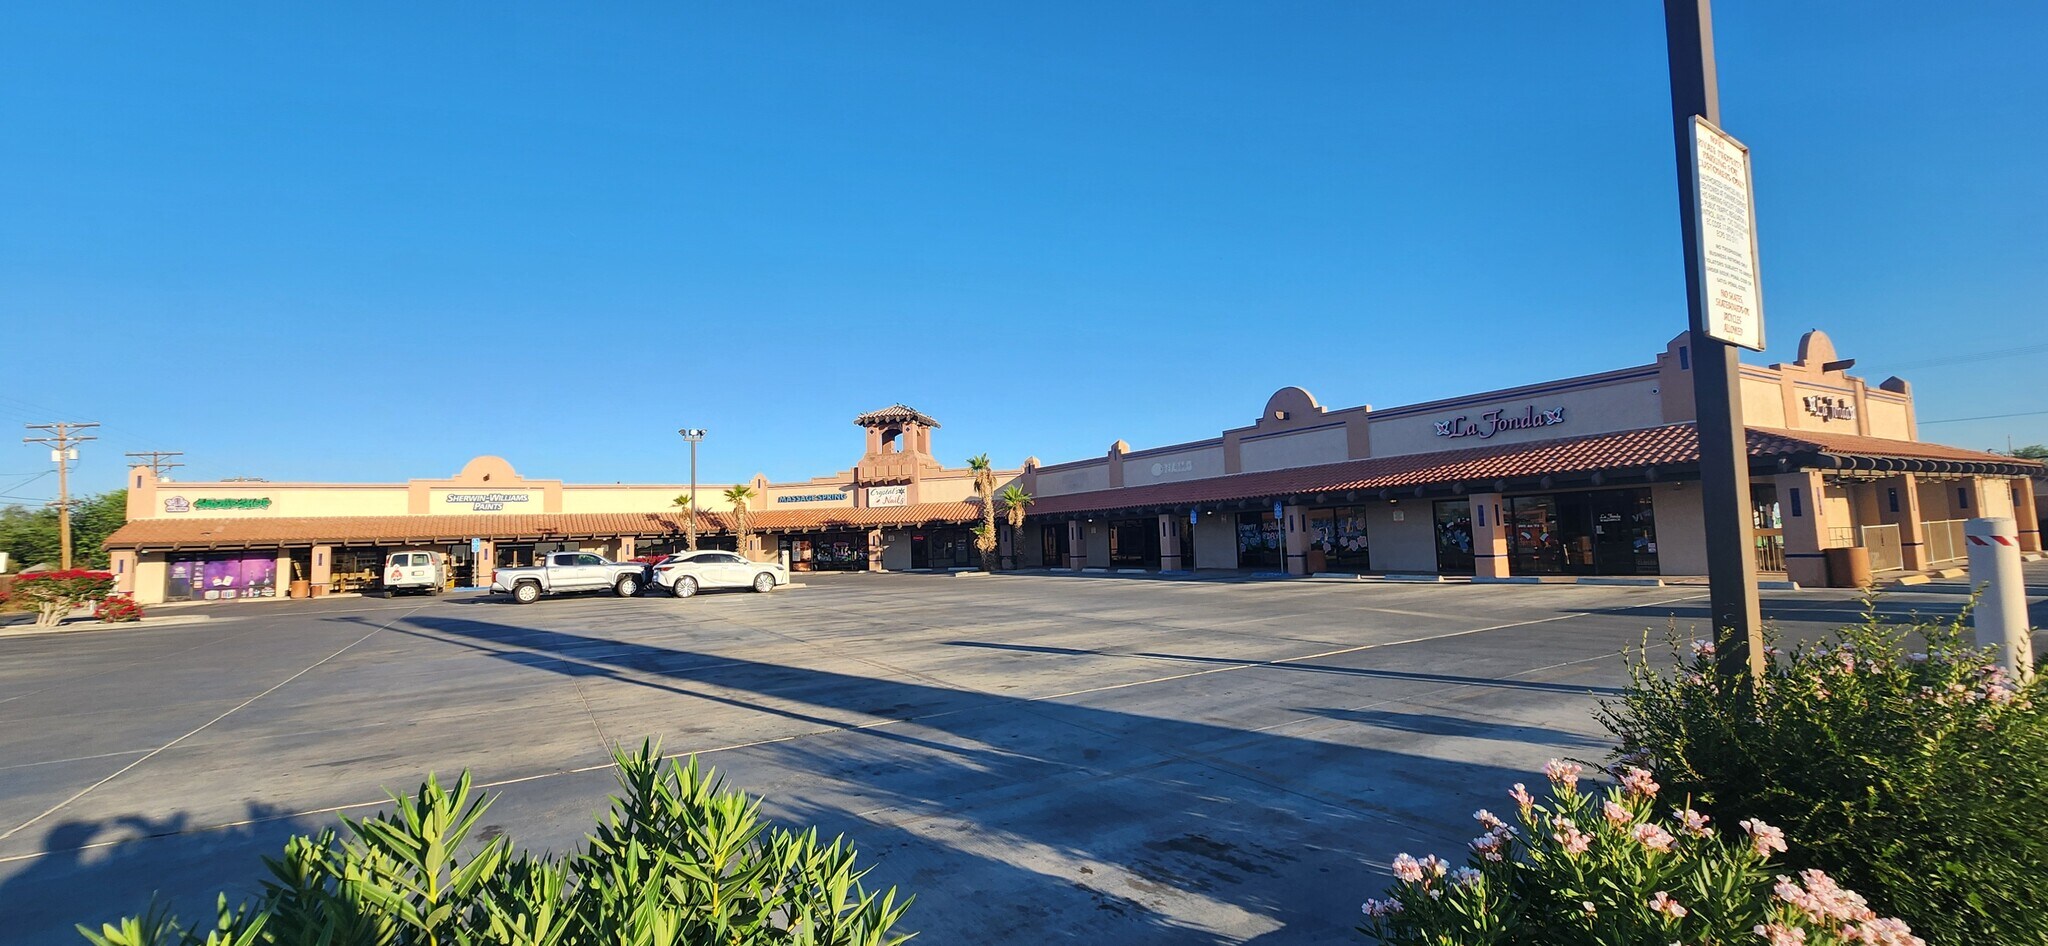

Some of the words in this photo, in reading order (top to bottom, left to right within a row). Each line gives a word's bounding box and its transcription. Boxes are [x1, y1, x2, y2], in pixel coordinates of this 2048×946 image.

[1449, 416, 1479, 438] La
[1480, 405, 1544, 439] Fonda
[446, 494, 529, 502] SHERWIN-WILLIAMS
[817, 493, 847, 502] SPRING
[883, 494, 904, 505] Nails
[473, 503, 503, 511] PAINTS
